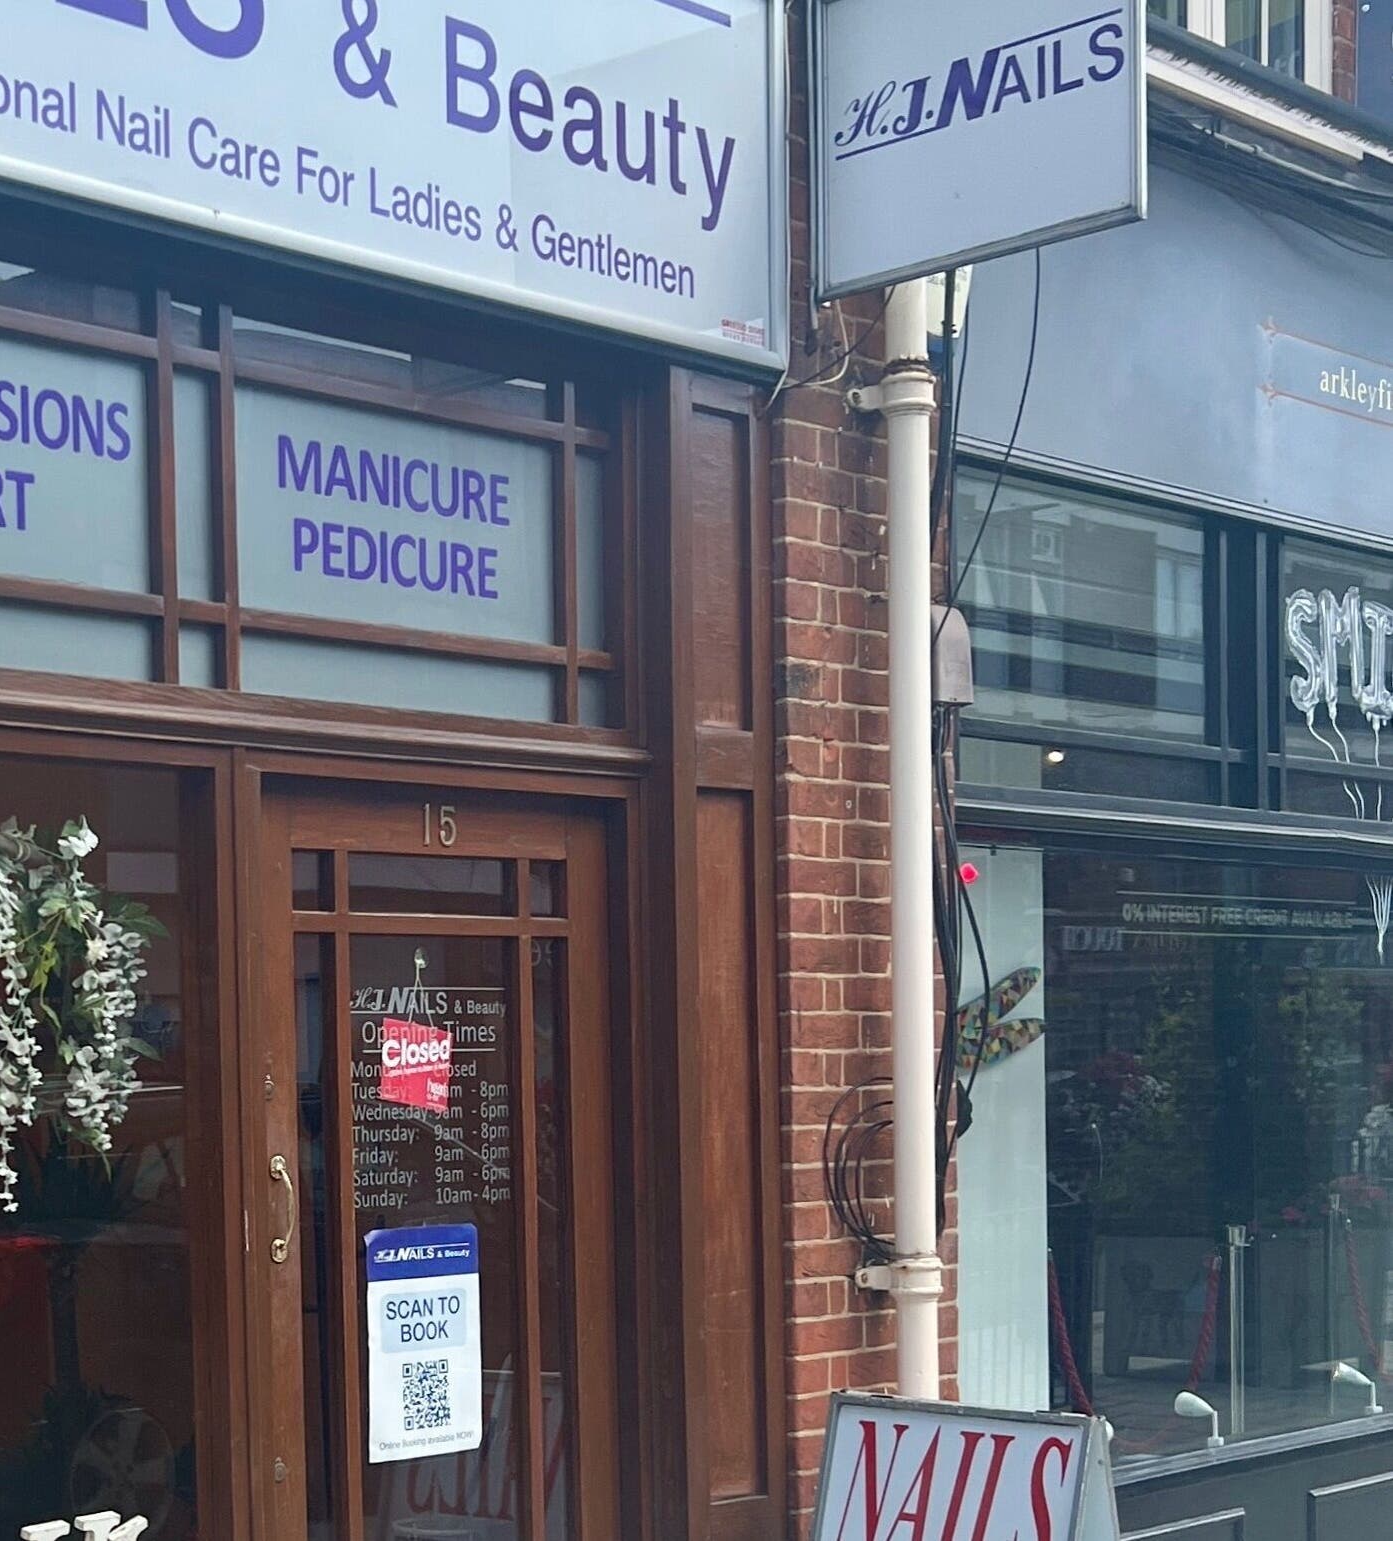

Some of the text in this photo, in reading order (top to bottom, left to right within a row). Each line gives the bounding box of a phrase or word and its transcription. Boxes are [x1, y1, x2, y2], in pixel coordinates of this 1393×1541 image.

[333, 0, 736, 231] & Beauty
[95, 88, 171, 160] Nail
[187, 116, 281, 187] Care
[296, 146, 355, 207] For
[369, 166, 482, 243] Ladies
[496, 204, 520, 253] &
[531, 213, 695, 298] Gentlemen
[277, 434, 511, 527] MANICURE
[293, 517, 499, 600] PEDICURE
[423, 803, 456, 847] 15
[1122, 903, 1144, 922] 0%
[1146, 903, 1207, 924] INTEREST
[1211, 906, 1243, 926] FREE
[454, 1001, 463, 1014] &
[467, 1000, 506, 1018] Beauty
[443, 1020, 496, 1044] Times
[381, 1033, 452, 1068] Closed
[479, 1081, 509, 1100] 8pm
[480, 1101, 510, 1121] 6pm
[351, 1123, 420, 1144] Thursday:
[434, 1123, 464, 1141] 9am
[480, 1122, 510, 1141] 8pm
[351, 1146, 399, 1167] Friday:
[434, 1145, 464, 1163] 9am
[481, 1143, 510, 1163] 6pm
[353, 1167, 418, 1187] Saturday:
[435, 1166, 464, 1183] 9am
[481, 1165, 510, 1184] 6pm
[353, 1188, 409, 1209] Sunday:
[482, 1184, 511, 1205] 4pm
[436, 1250, 444, 1258] &
[444, 1249, 470, 1258] Beauty
[386, 1295, 460, 1320] SCAN TO
[400, 1320, 449, 1342] BOOK
[837, 1420, 1074, 1541] NAILS
